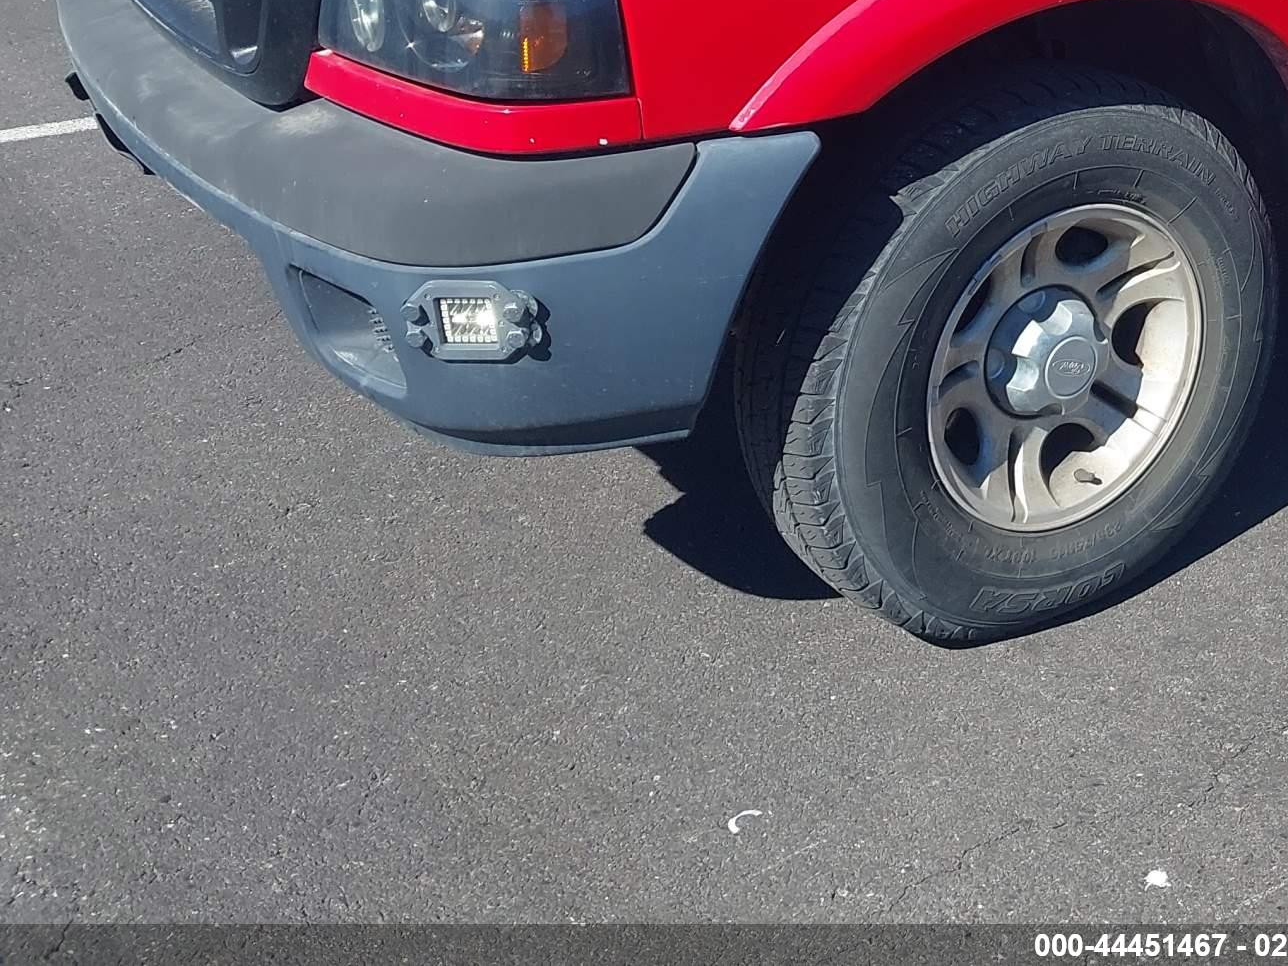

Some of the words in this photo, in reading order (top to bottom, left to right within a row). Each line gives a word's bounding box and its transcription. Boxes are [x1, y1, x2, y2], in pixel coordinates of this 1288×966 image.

[944, 135, 1092, 238] HIGHWAY
[1099, 134, 1217, 186] TERRAIN
[968, 560, 1127, 614] CORSA
